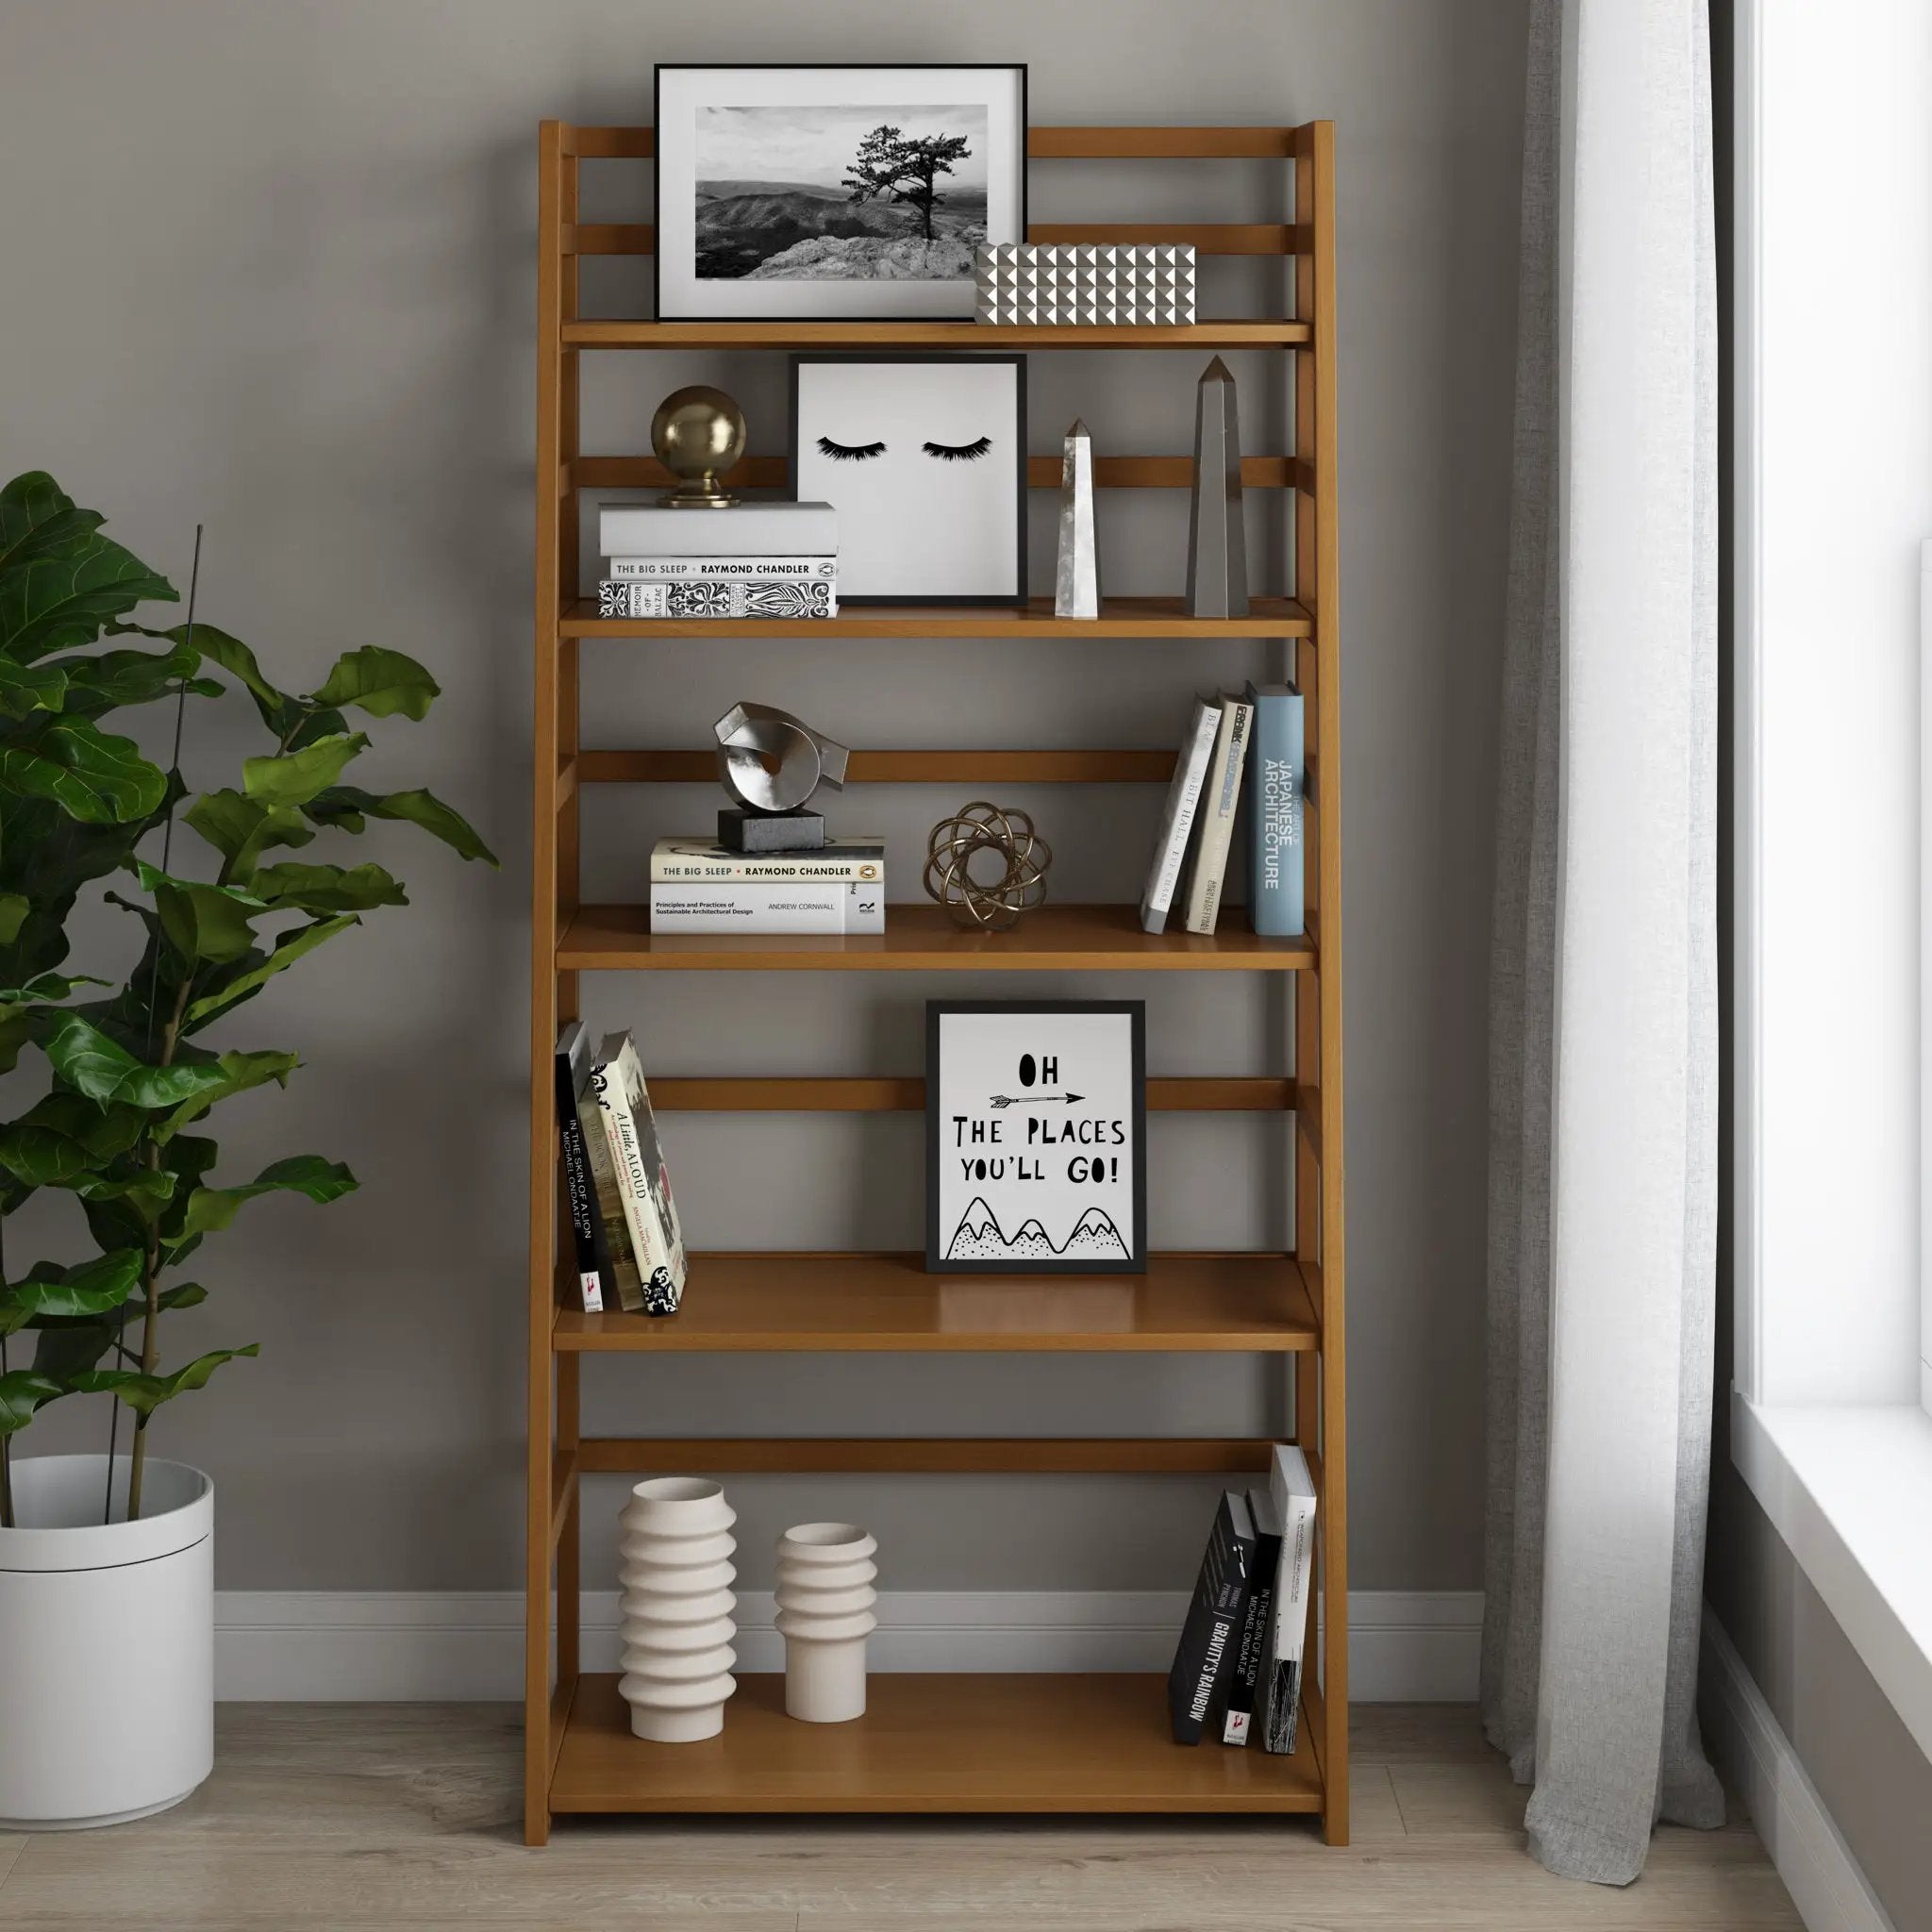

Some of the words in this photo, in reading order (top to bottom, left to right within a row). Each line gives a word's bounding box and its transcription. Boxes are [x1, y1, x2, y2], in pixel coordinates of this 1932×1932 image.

[618, 565, 635, 574] THE
[639, 565, 656, 574] BIG
[660, 565, 687, 574] SLEEP
[702, 565, 752, 574] RAYMOND
[758, 565, 809, 574] CHANDLER
[1231, 705, 1247, 743] FRANK
[1278, 759, 1291, 845] JAPANESE
[1174, 809, 1191, 842] HALL
[1265, 758, 1278, 889] ARCHITECTURE
[1019, 1054, 1058, 1087] OH
[569, 1119, 576, 1129] IN
[616, 1110, 627, 1120] A
[571, 1132, 580, 1154] THE
[618, 1122, 636, 1151] Little,
[953, 1116, 1003, 1147] THE
[1028, 1117, 1125, 1145] PLACES
[561, 1131, 575, 1174] MICHAEL
[574, 1157, 584, 1183] SKIN
[625, 1151, 647, 1199] ALOUD
[1068, 1156, 1118, 1183] GO!
[567, 1176, 581, 1228] ONDAATJE
[577, 1185, 586, 1200] OF
[579, 1202, 588, 1210] A
[580, 1212, 591, 1239] LION
[632, 1206, 643, 1229] ANGELA
[638, 1229, 651, 1265] MACMILLAN
[1260, 1589, 1270, 1598] IN
[1244, 1595, 1257, 1631] MICHAEL
[1257, 1600, 1268, 1618] THE
[1253, 1619, 1265, 1641] SKIN
[1202, 1621, 1229, 1674] GRAVITY'S
[1237, 1632, 1249, 1674] ONDAATJE
[1251, 1641, 1260, 1655] OF
[1245, 1664, 1256, 1686] LION
[1188, 1673, 1213, 1722] RAINBOW
